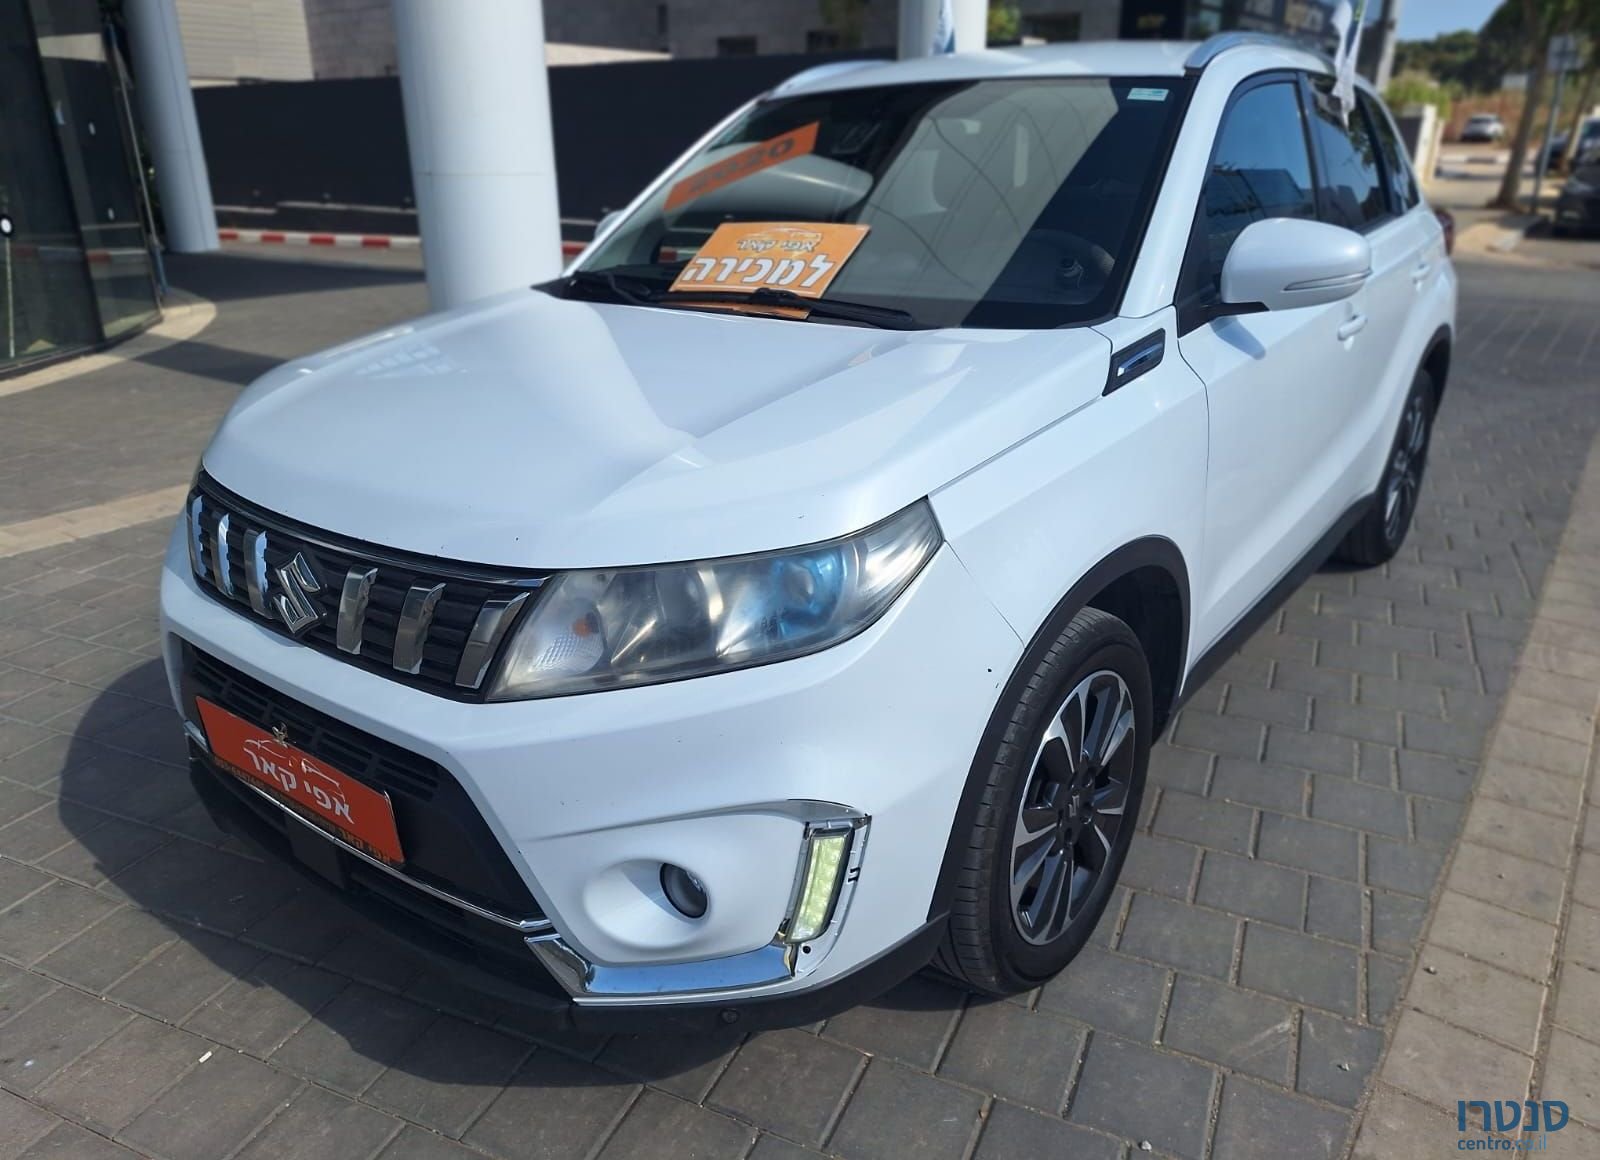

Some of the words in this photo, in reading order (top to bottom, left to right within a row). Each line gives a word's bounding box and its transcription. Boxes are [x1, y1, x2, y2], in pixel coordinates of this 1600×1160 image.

[681, 255, 834, 288] למכירה
[243, 748, 297, 792] קאר
[304, 780, 354, 824] אפי
